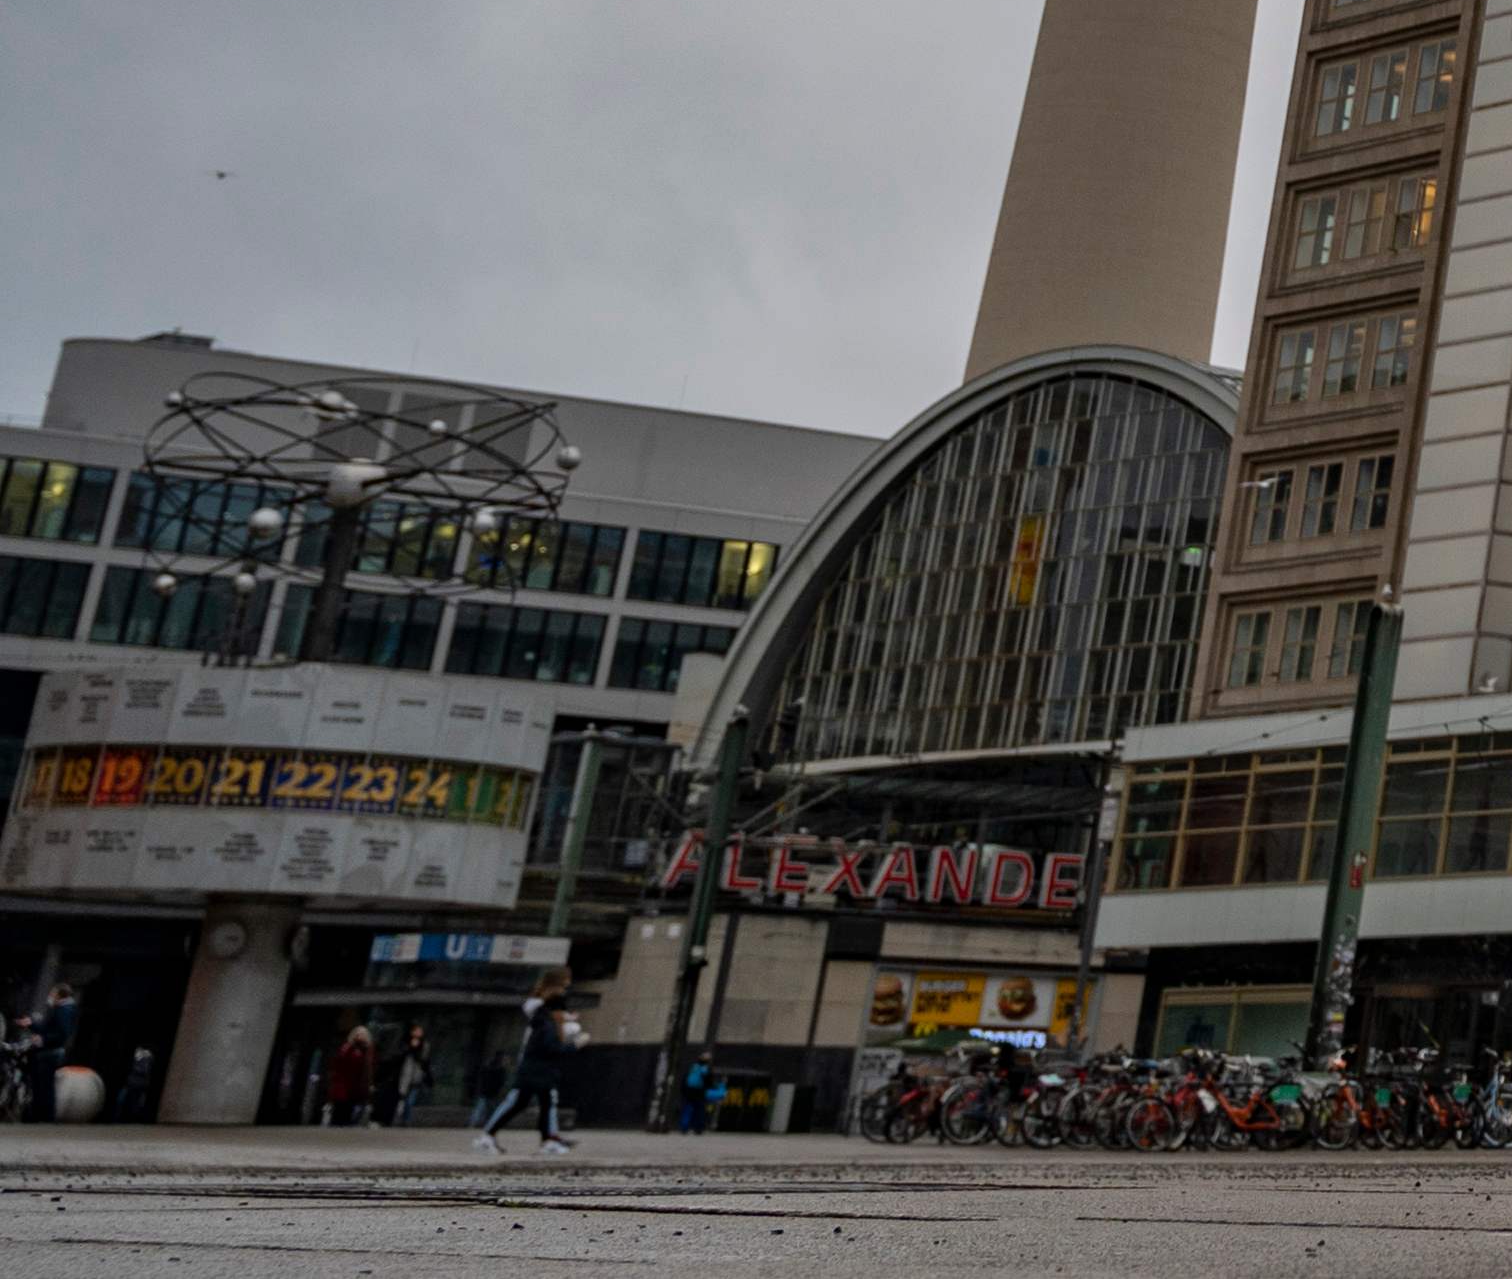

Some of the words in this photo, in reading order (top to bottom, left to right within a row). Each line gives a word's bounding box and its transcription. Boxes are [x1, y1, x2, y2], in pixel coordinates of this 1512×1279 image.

[61, 757, 92, 793] 18
[101, 753, 143, 794] 19
[145, 757, 204, 794] 20
[211, 757, 265, 795] 21
[273, 760, 337, 799] 22
[341, 764, 398, 803] 23
[401, 768, 450, 807] 24
[661, 829, 1085, 909] ALEXANDE
